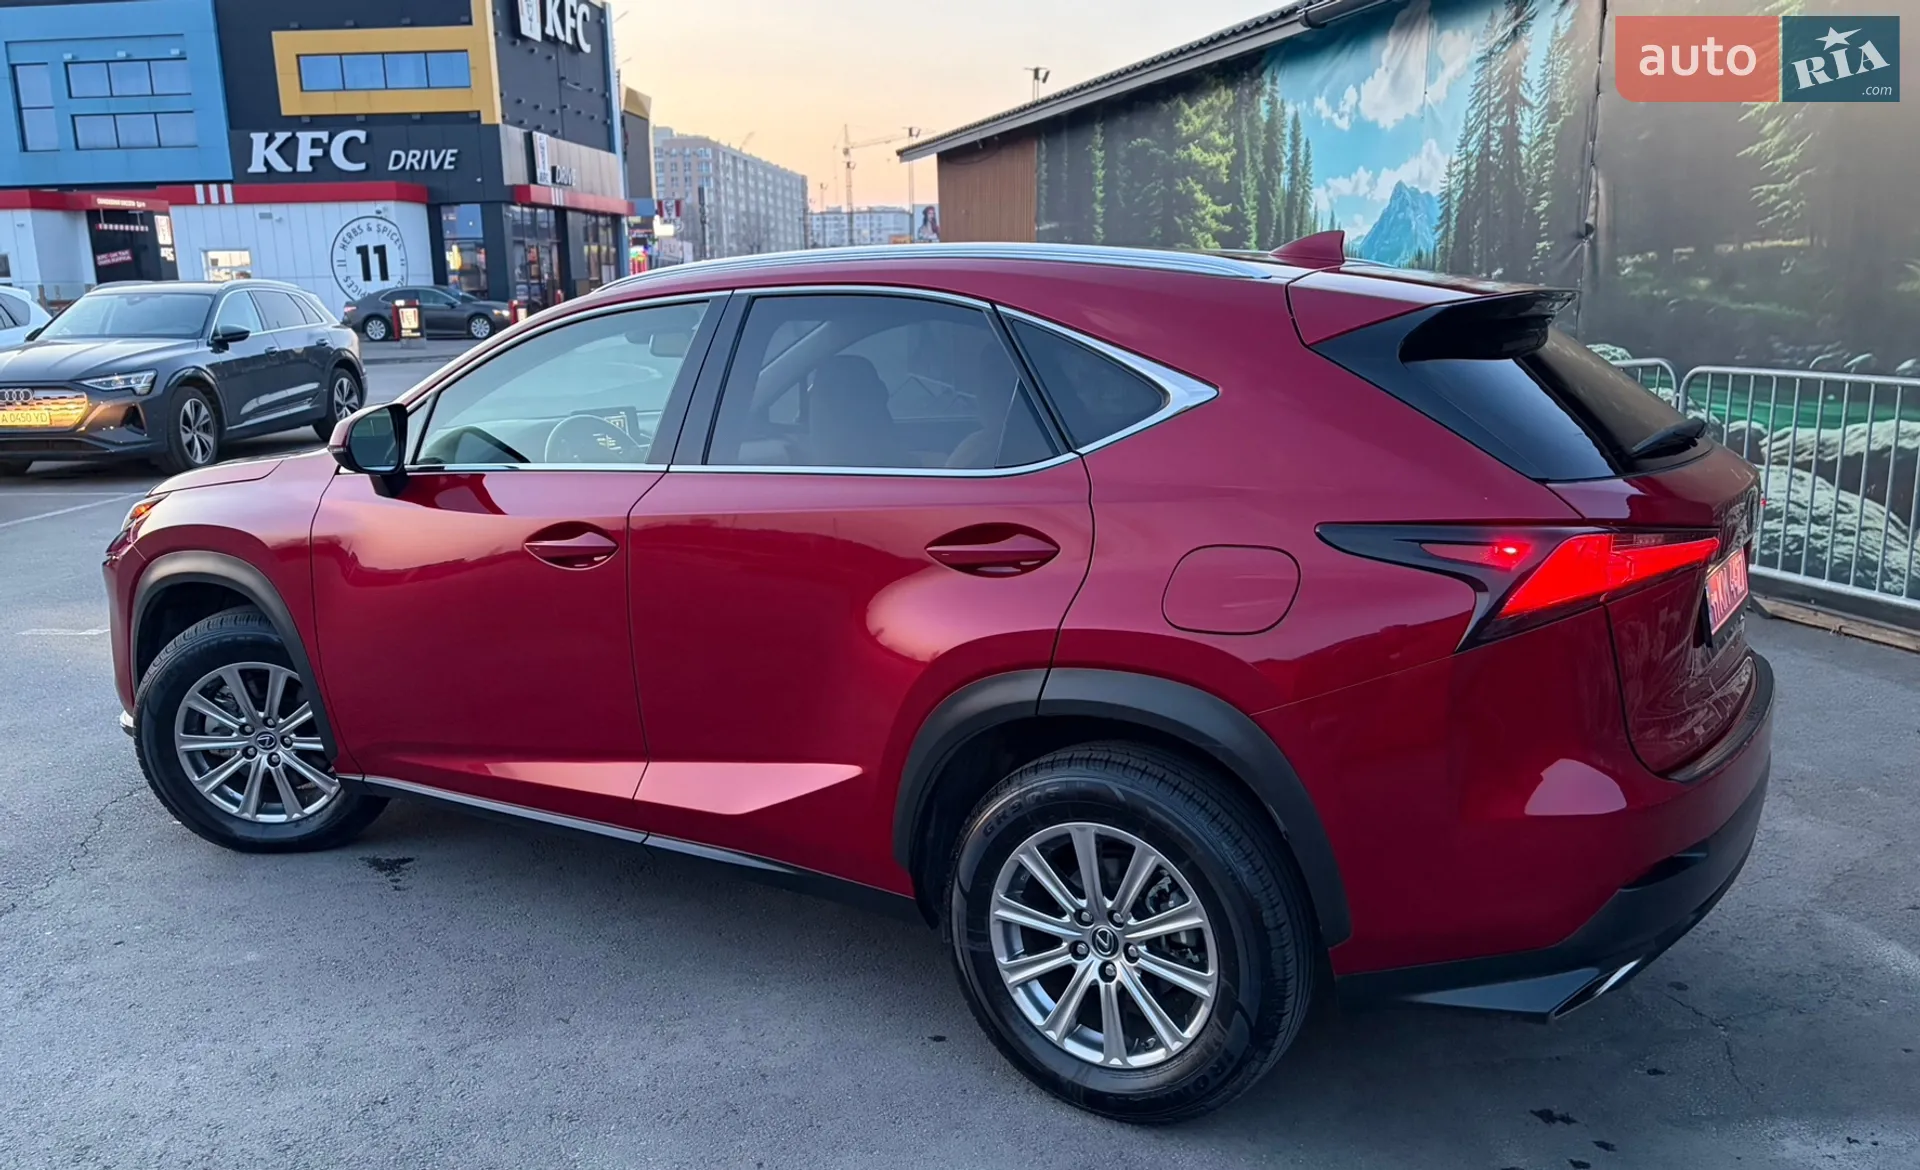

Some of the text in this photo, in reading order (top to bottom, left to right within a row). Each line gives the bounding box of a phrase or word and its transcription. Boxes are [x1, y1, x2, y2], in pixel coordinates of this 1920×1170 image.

[545, 0, 591, 53] KFC
[247, 130, 458, 173] KFC DRIVE
[556, 164, 577, 187] DRIVE
[340, 222, 403, 252] HERBS & SPICES
[355, 244, 390, 282] 11
[9, 411, 32, 423] 0450
[33, 411, 48, 423] YD
